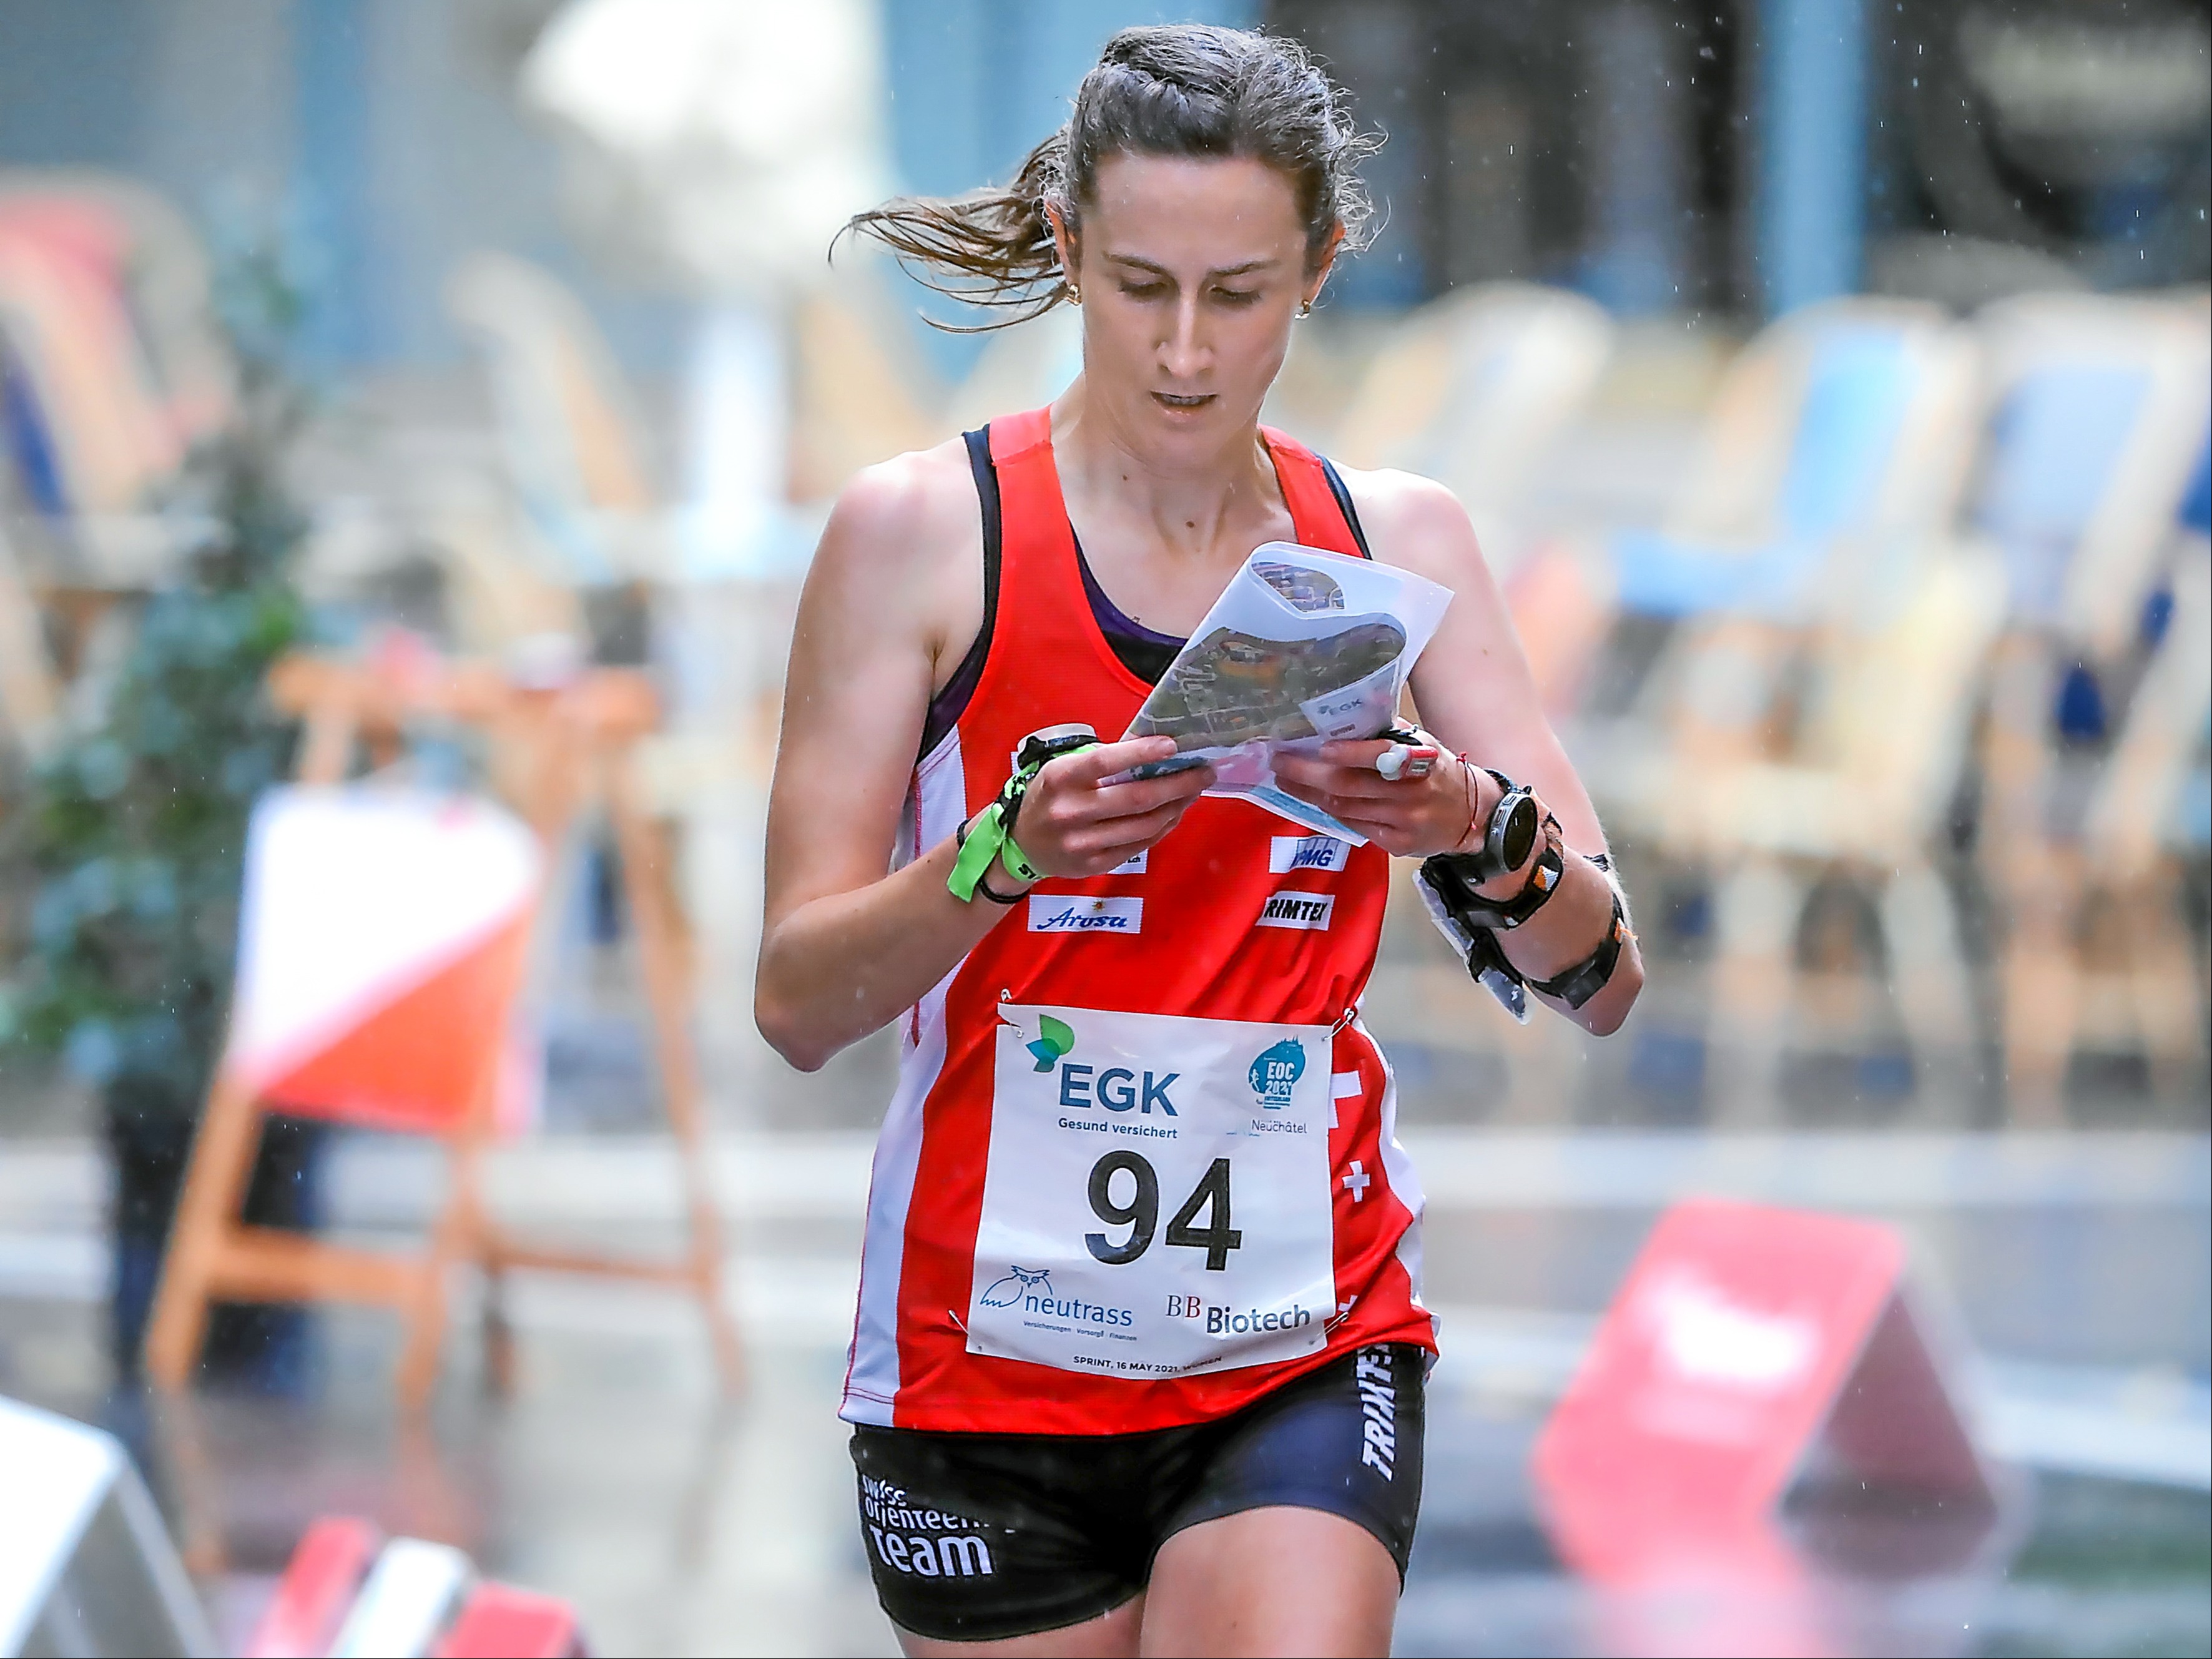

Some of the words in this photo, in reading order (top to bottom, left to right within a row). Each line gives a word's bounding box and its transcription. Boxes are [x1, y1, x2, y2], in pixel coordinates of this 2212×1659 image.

[1036, 907, 1128, 930] Arosa
[1263, 898, 1328, 921] RIMTEX
[1267, 1061, 1295, 1080] EOC
[1059, 1063, 1181, 1116] EGK
[1265, 1080, 1292, 1095] 2021
[1058, 1118, 1108, 1132] Gesund
[1112, 1125, 1178, 1139] versichert
[1084, 1150, 1242, 1271] 94
[1025, 1294, 1133, 1327] neutrass
[1206, 1304, 1310, 1334] Biotech
[1116, 1361, 1126, 1370] 16
[1129, 1362, 1153, 1371] MAY
[869, 1524, 993, 1577] team
